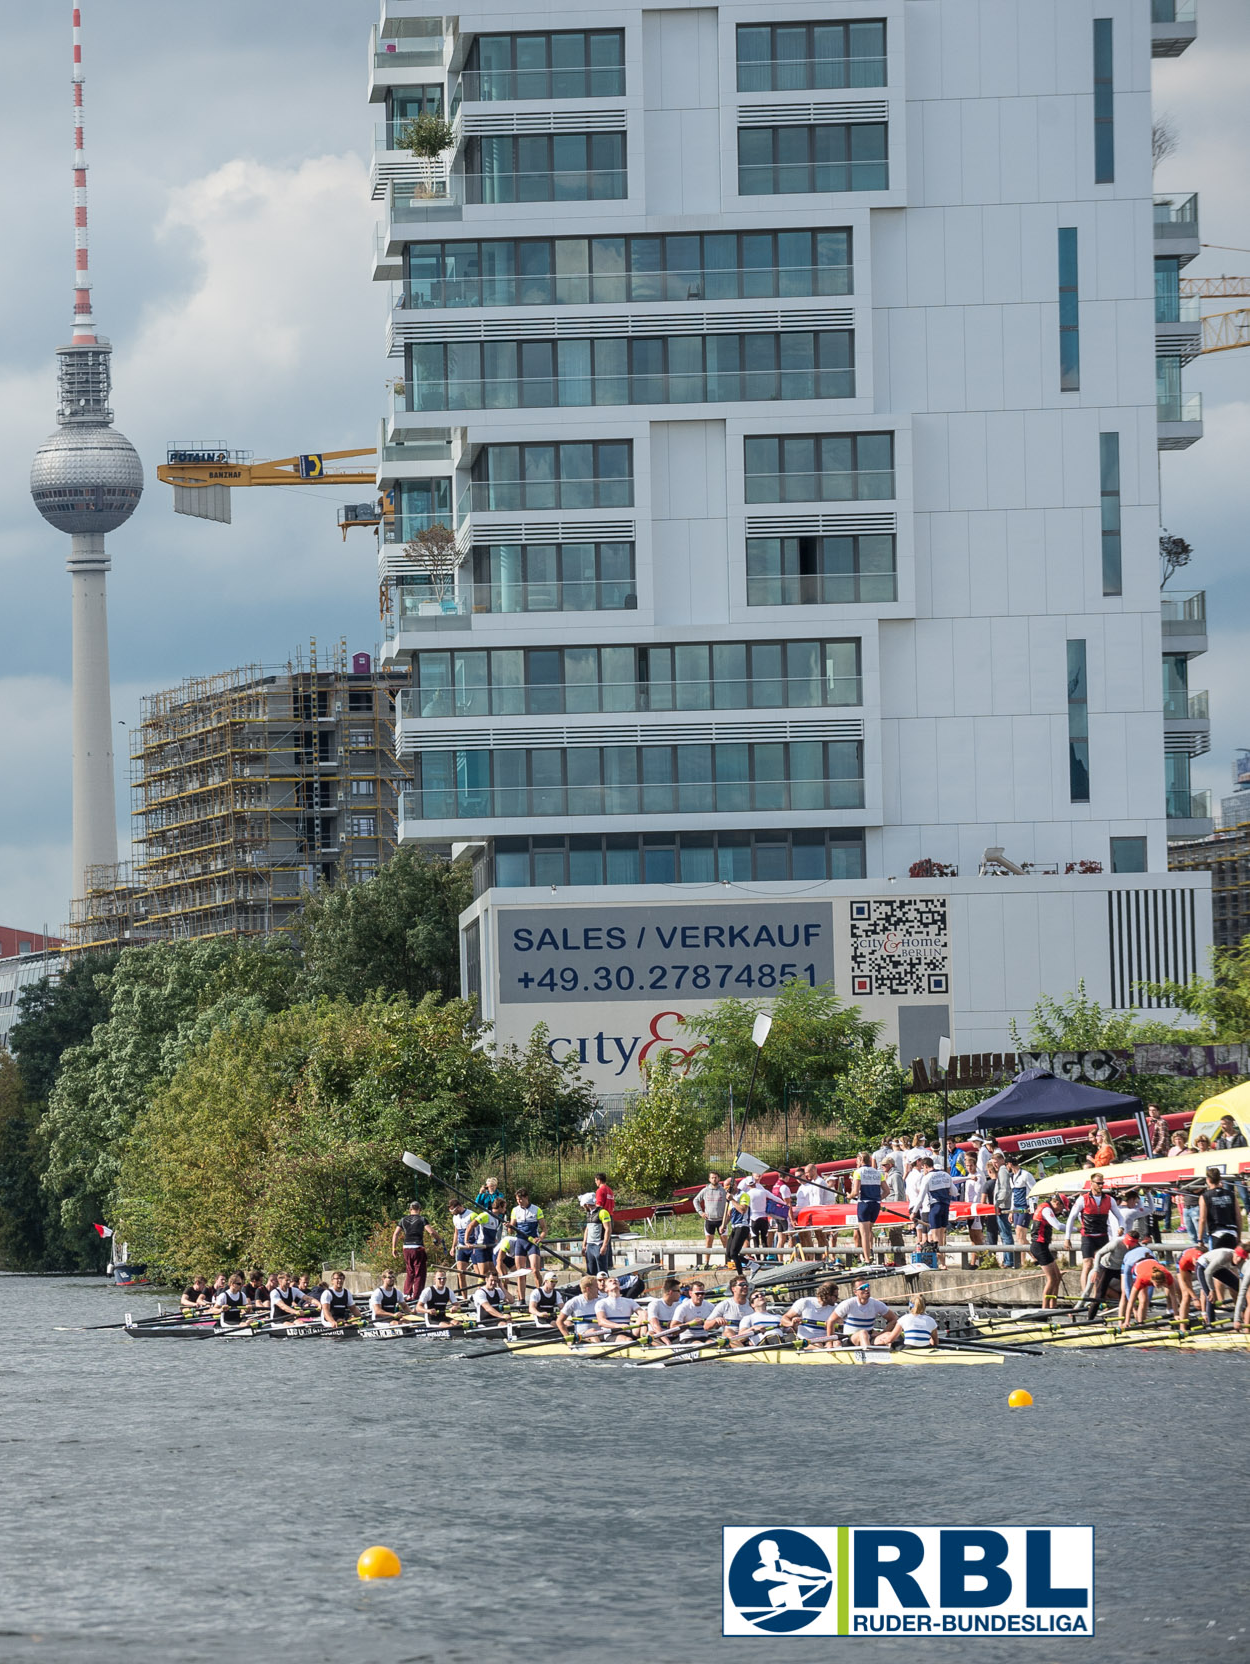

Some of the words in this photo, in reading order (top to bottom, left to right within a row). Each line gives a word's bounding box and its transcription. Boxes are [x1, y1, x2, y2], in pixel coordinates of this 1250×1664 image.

[170, 453, 215, 462] POTAIN
[513, 926, 627, 952] SALES
[637, 926, 646, 950] /
[655, 923, 822, 948] VERKAUF
[516, 962, 816, 992] +49.30.27874851
[1019, 1136, 1063, 1149] BERNBURG
